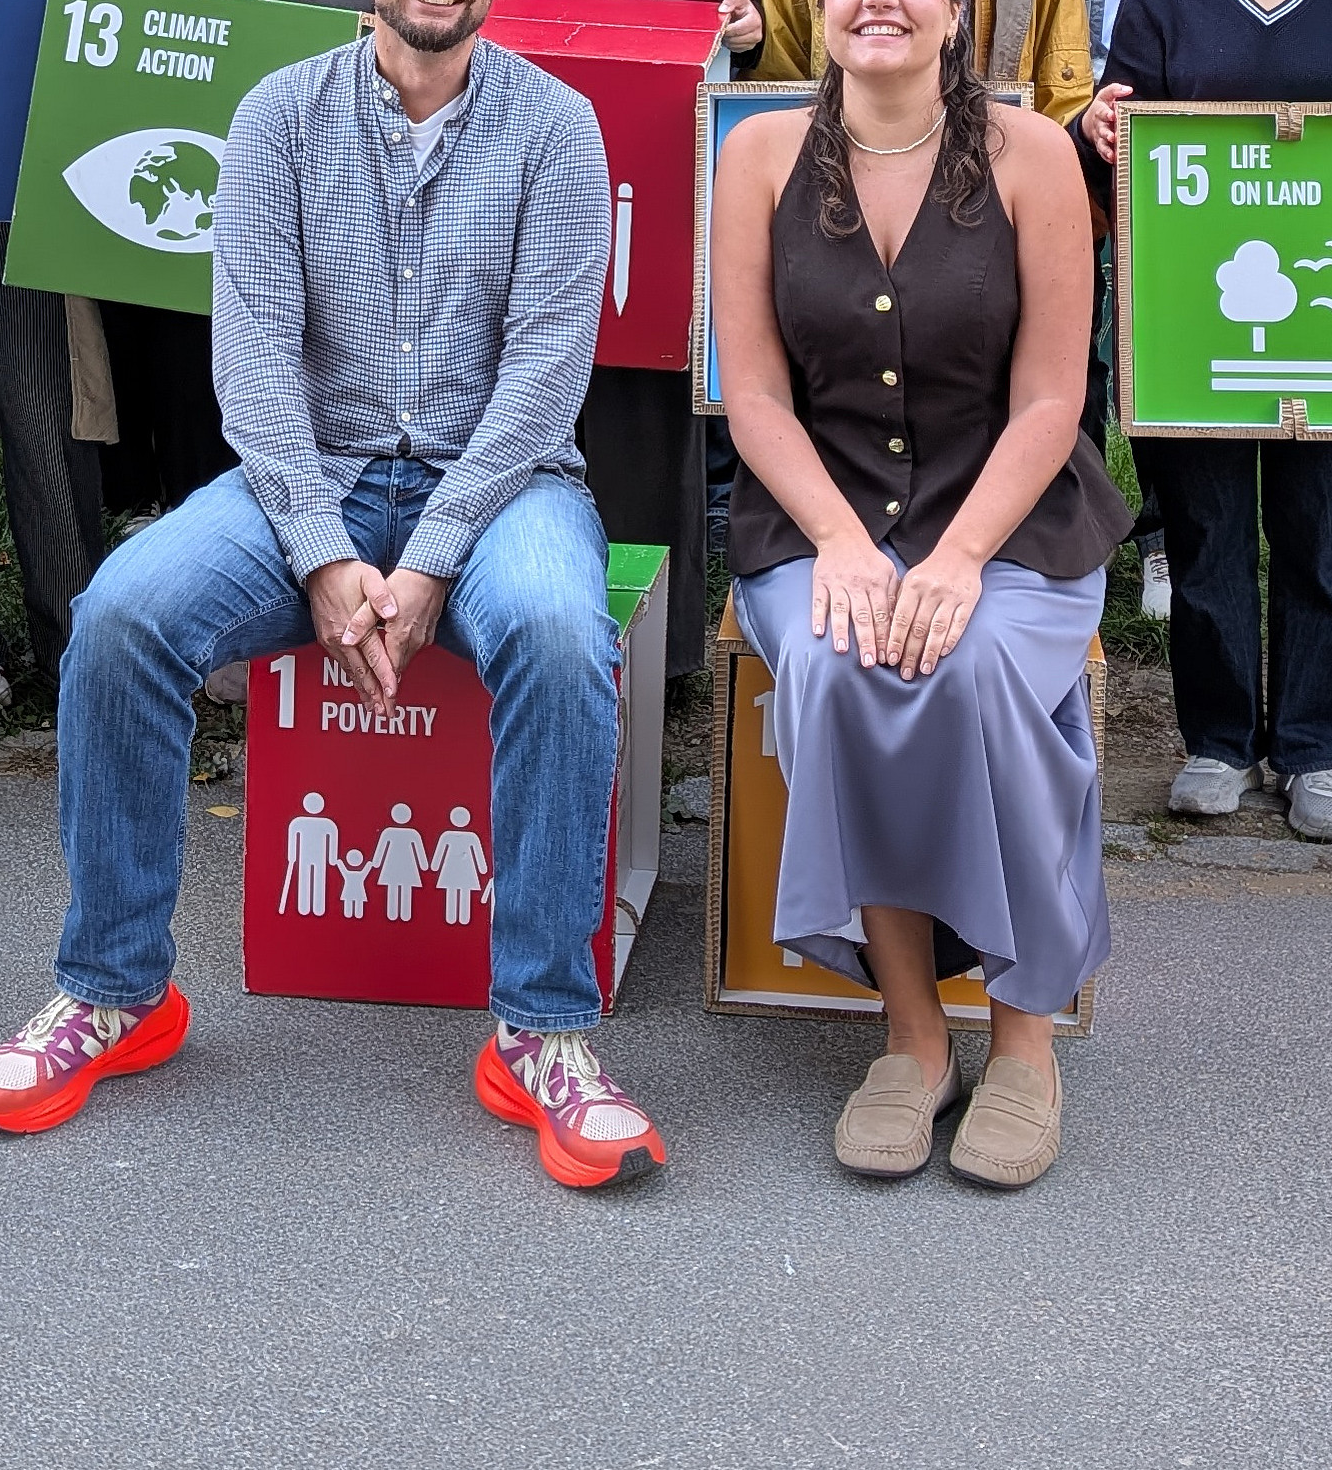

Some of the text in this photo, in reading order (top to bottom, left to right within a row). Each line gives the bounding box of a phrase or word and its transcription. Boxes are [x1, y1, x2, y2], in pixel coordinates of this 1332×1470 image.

[63, 0, 123, 68] 13
[143, 9, 232, 47] CLIMATE
[136, 48, 215, 84] ACTION
[1149, 144, 1210, 207] 15
[1230, 144, 1273, 170] LIFE
[1230, 180, 1322, 207] ON LAND
[270, 654, 296, 729] 1
[321, 701, 438, 737] POVERTY
